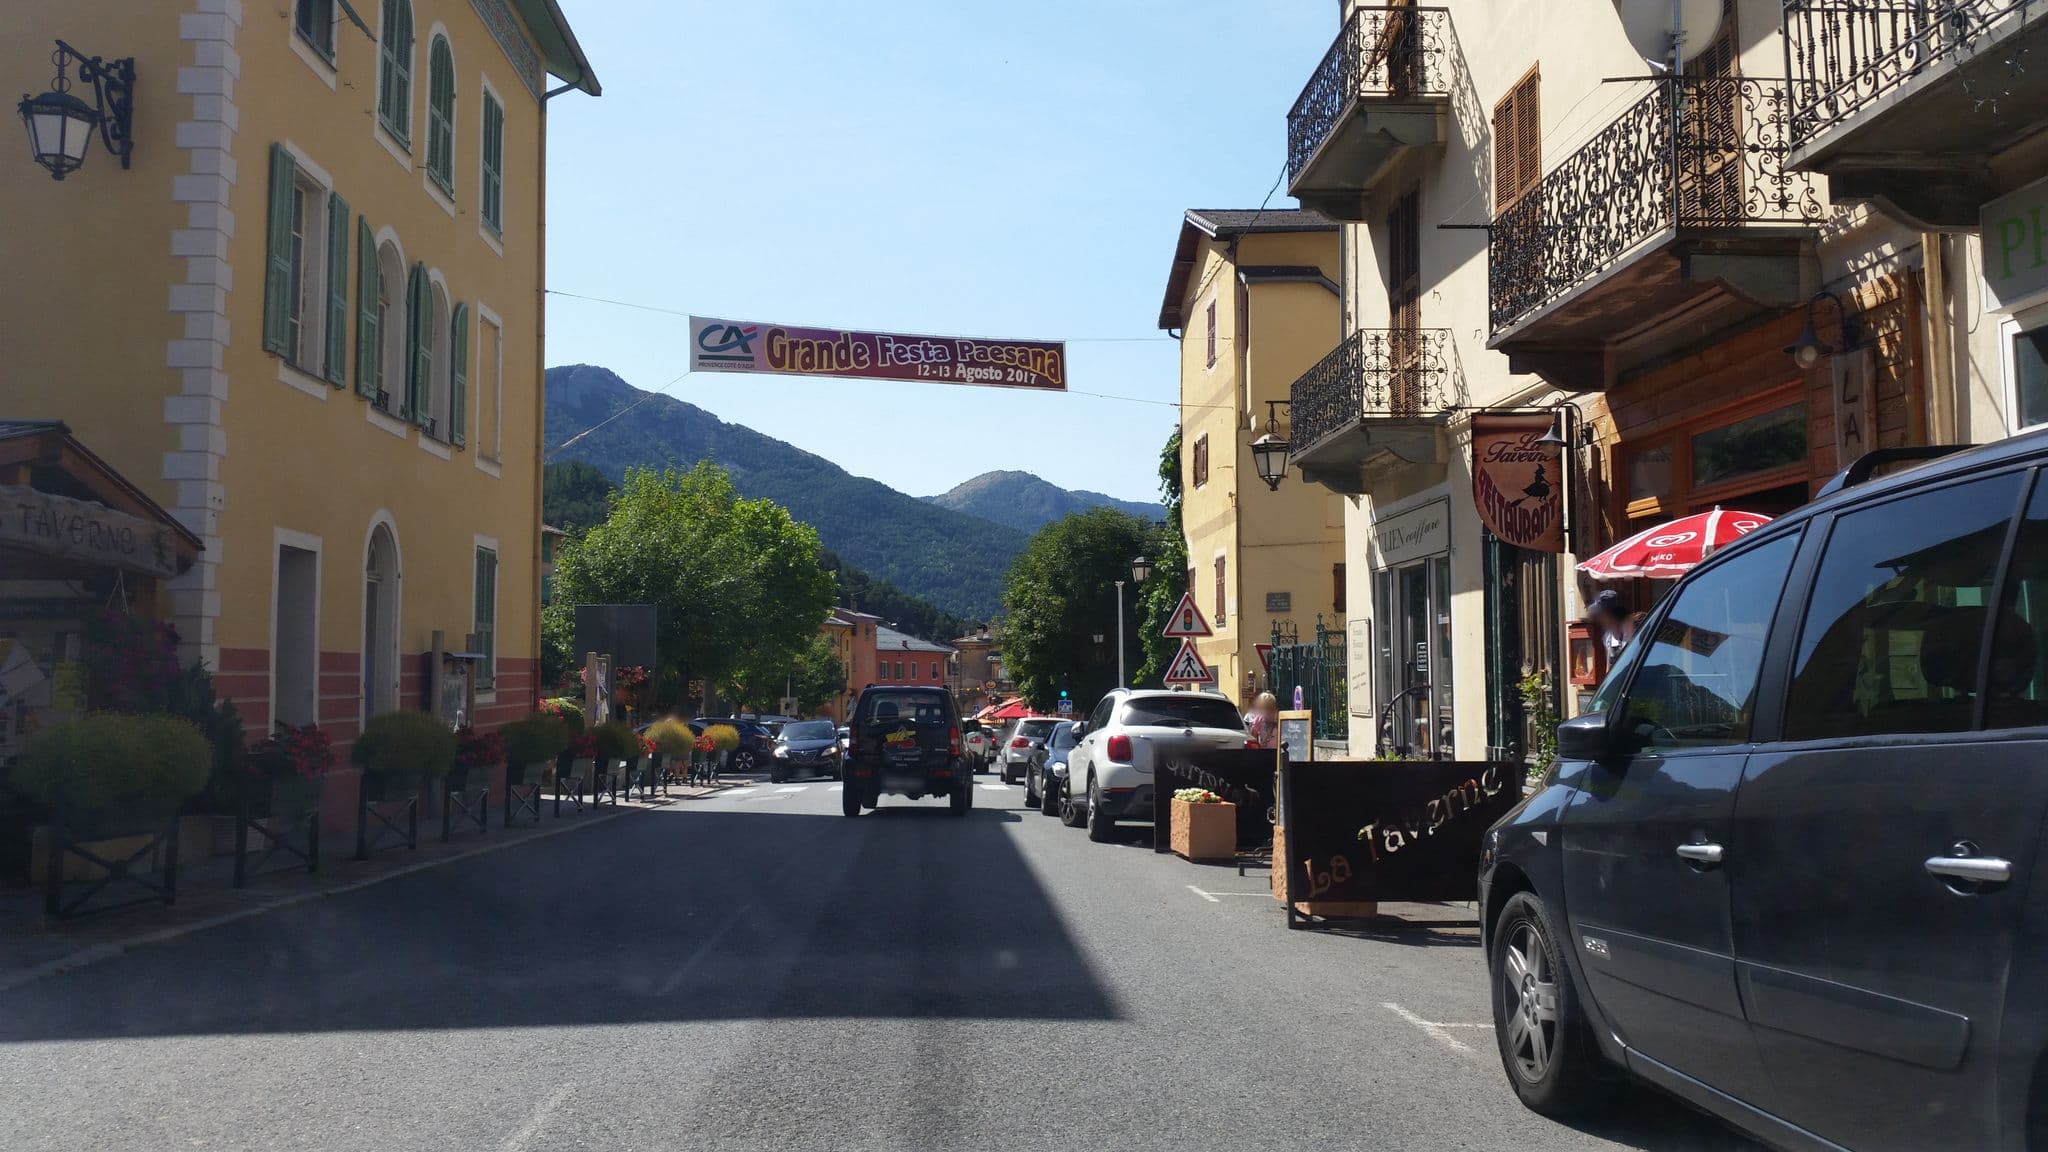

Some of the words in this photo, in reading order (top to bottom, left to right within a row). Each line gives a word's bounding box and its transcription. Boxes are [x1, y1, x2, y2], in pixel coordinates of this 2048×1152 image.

[766, 328, 870, 372] Grande
[876, 336, 951, 367] Festa
[954, 341, 1062, 384] Paesana
[955, 364, 1003, 381] Agosto
[1006, 368, 1037, 384] 2017
